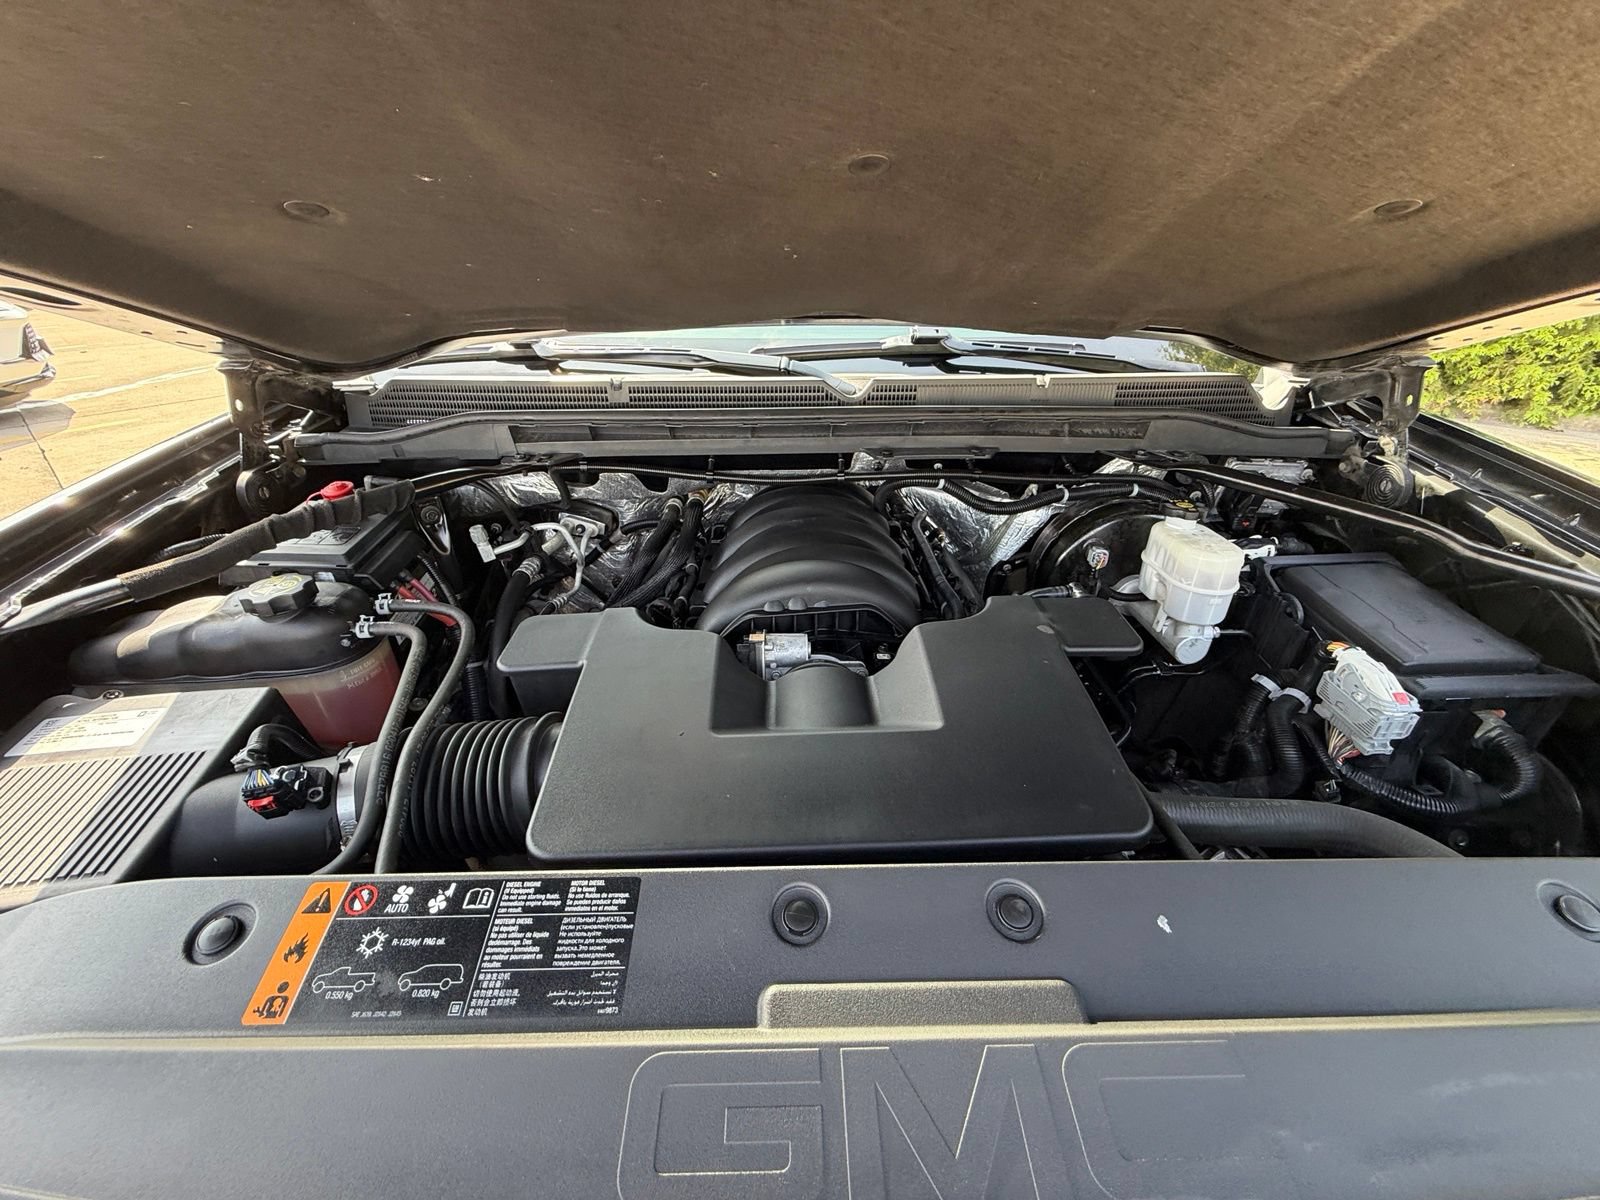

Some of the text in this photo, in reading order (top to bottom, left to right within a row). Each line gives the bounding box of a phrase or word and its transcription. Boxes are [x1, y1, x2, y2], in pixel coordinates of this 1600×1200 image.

[384, 903, 409, 913] AUTO
[391, 937, 446, 946] R-1234yf PAG oil.
[325, 991, 353, 1001] 0.550 kg
[412, 989, 440, 999] 0.820 kg
[467, 1007, 488, 1016] 发动机
[616, 1040, 1284, 1200] GMC
